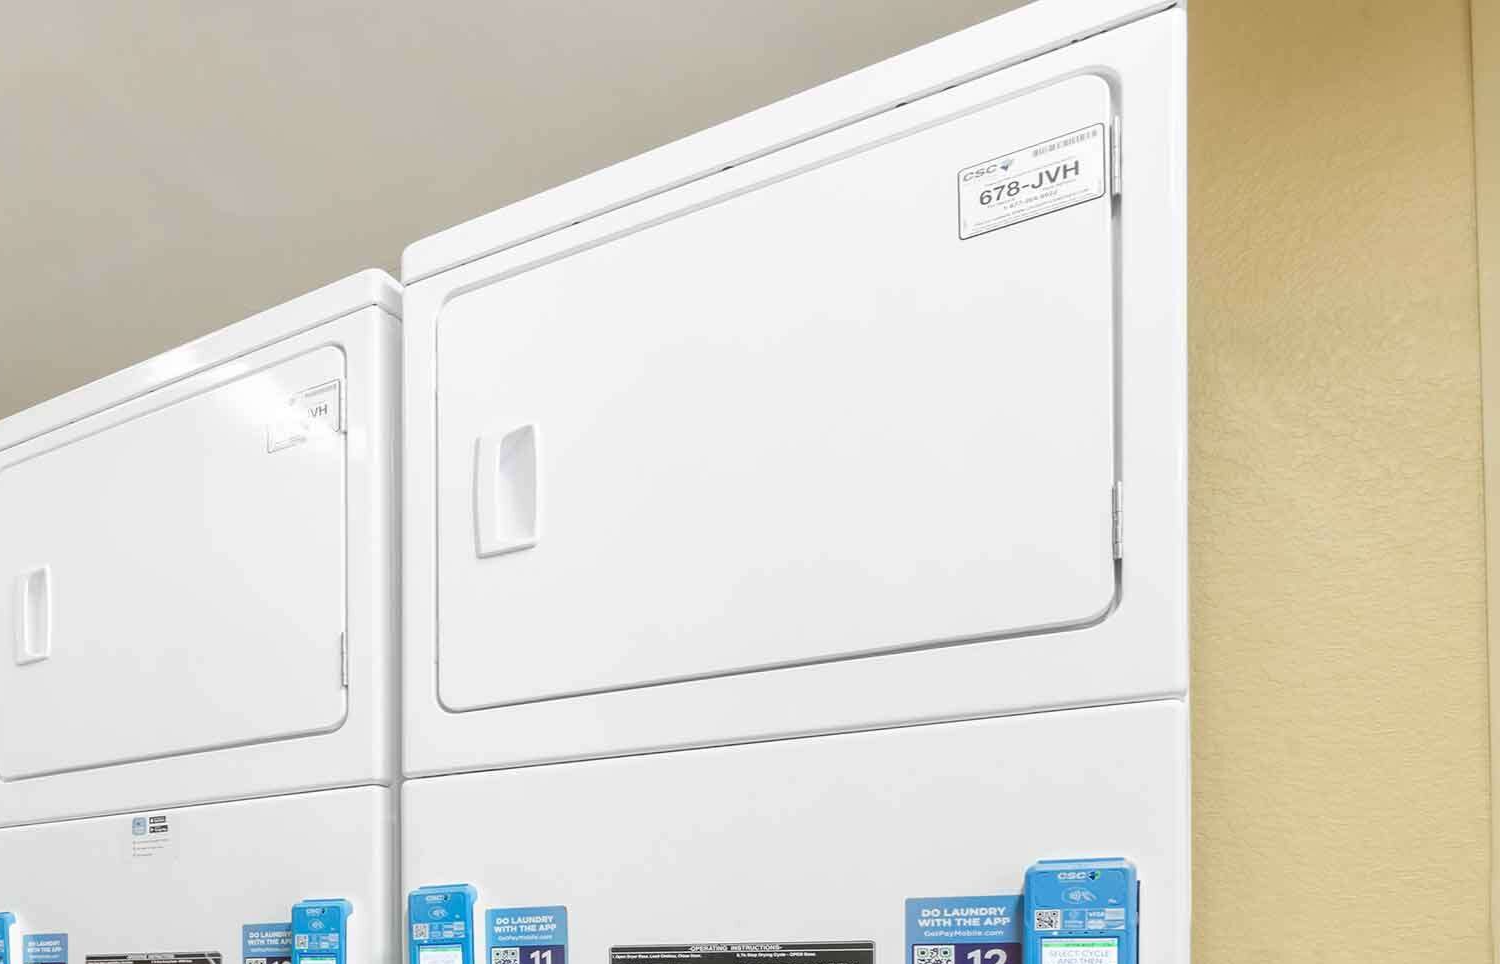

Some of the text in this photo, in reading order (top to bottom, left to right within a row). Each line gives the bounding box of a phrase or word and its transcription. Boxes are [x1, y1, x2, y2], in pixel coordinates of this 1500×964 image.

[962, 164, 998, 182] CSC
[979, 159, 1080, 206] 678-JVH
[921, 906, 1007, 919] DO LAUNDRY
[495, 915, 554, 925] DO LAUNDRY
[917, 916, 1012, 928] WITH THE APP
[493, 923, 557, 934] WITH THE APP
